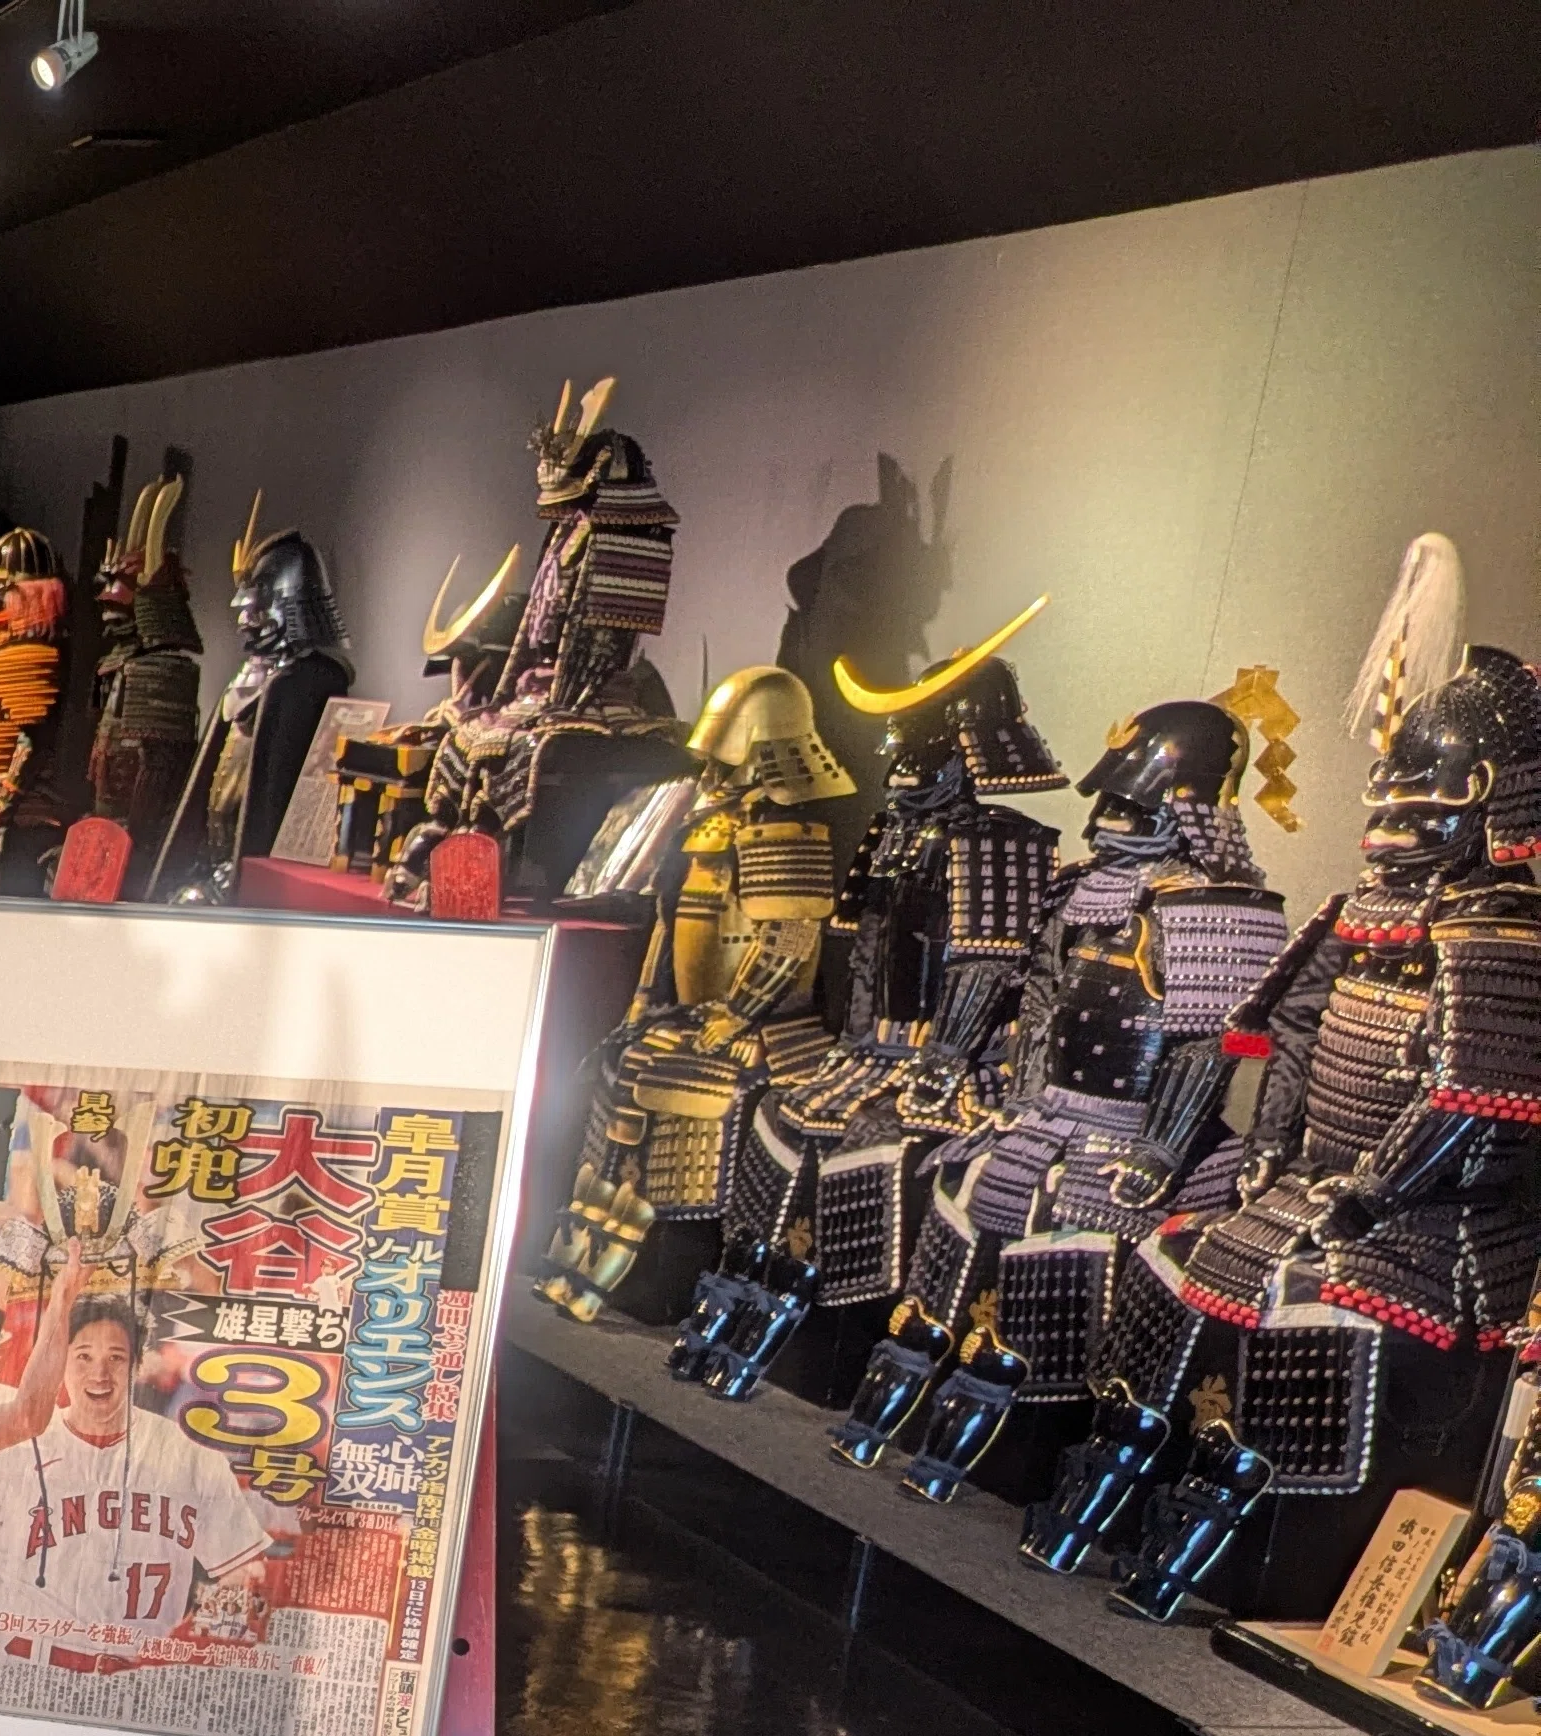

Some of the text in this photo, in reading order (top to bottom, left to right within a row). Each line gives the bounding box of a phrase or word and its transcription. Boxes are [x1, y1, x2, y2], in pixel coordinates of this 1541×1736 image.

[145, 1099, 252, 1200] 初兜
[200, 1105, 379, 1300] 大谷
[370, 1113, 459, 1235] 皐月賞
[213, 1303, 344, 1347] 雄星撃ち
[332, 1255, 442, 1433] オリエンス
[179, 1346, 330, 1502] 3号
[26, 1491, 198, 1559] ANGELS
[123, 1563, 171, 1620] 17
